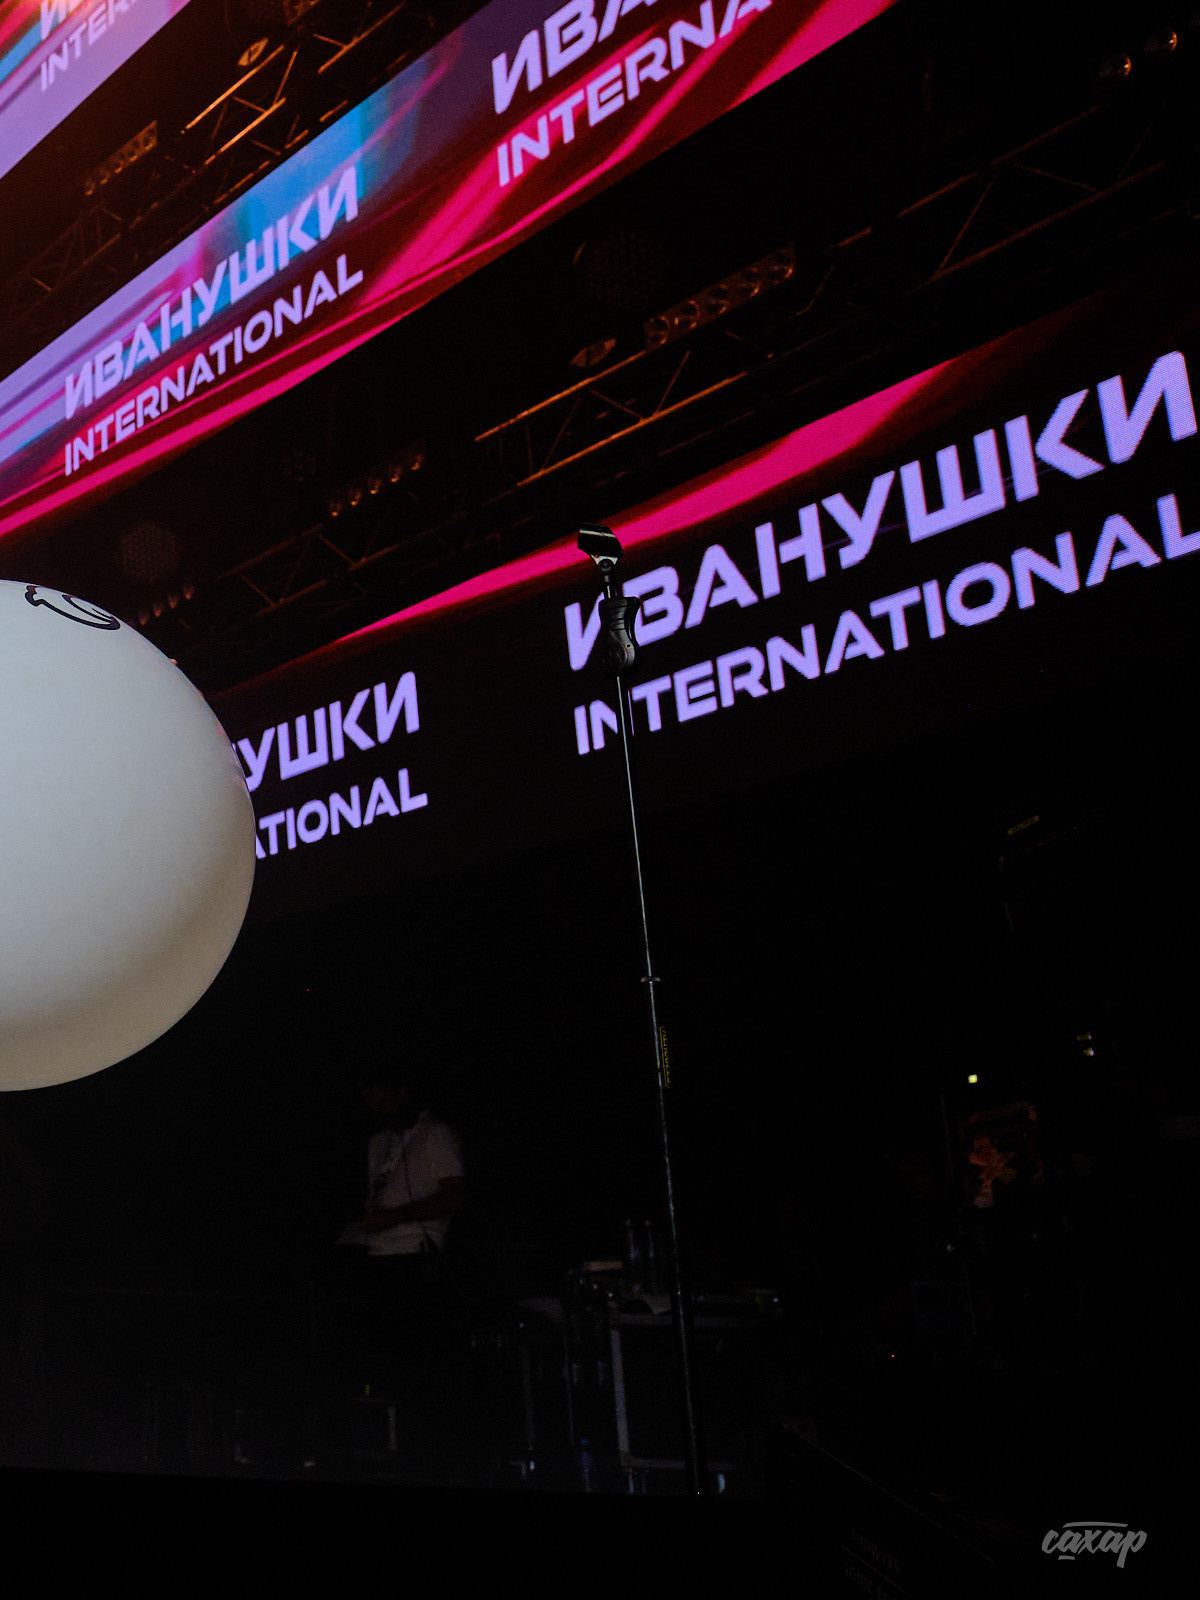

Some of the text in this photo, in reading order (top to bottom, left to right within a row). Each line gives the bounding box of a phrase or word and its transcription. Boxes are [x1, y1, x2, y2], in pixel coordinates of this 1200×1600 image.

[64, 254, 363, 476] INTERNATIONAL
[65, 165, 359, 419] ИВАНУШКИ
[564, 350, 1198, 672] ИВАНУШКИ
[574, 493, 1200, 755] INTERNATIONAL
[231, 671, 420, 793] УШКИ
[256, 768, 428, 859] TIONAL
